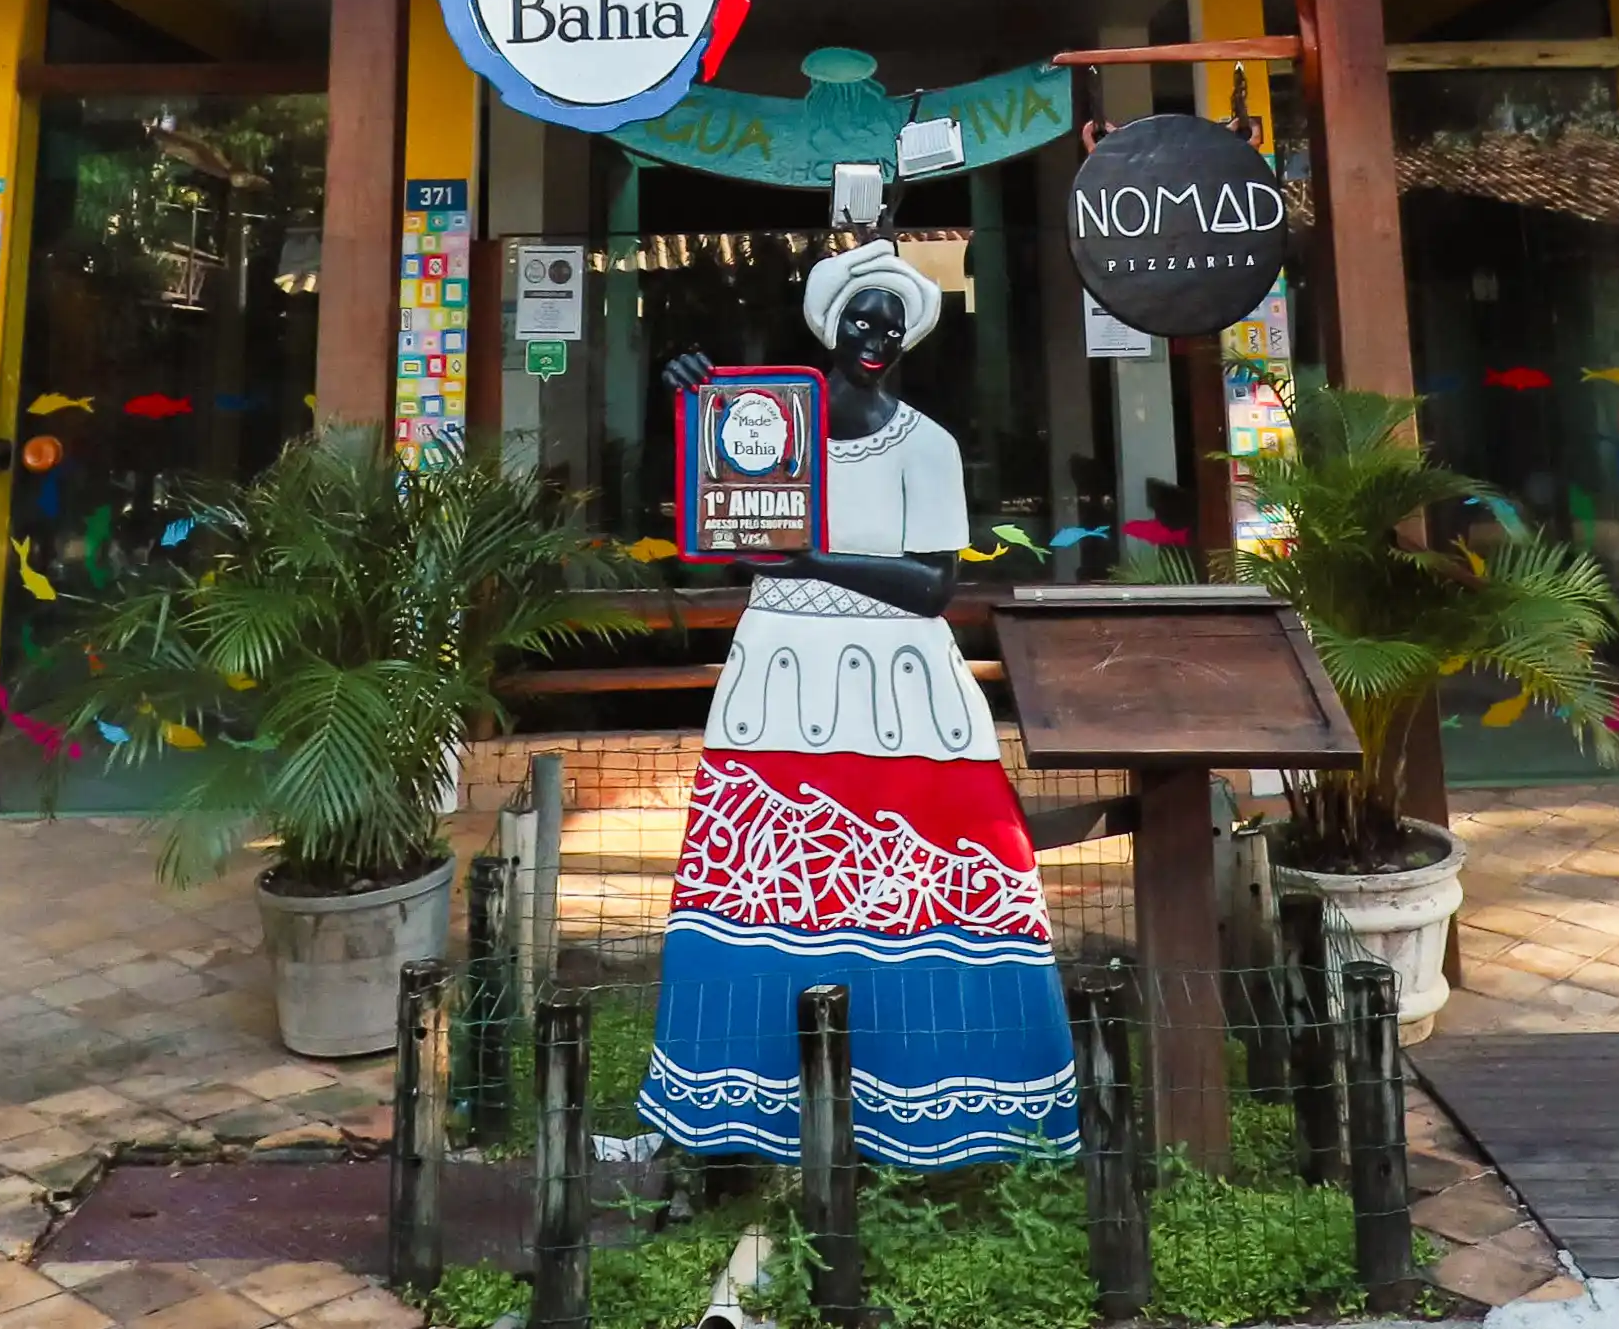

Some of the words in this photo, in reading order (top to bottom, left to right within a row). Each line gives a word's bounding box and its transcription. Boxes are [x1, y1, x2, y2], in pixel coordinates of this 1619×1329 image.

[643, 97, 772, 161] GUA
[419, 186, 453, 206] 371
[1075, 181, 1285, 239] NOMAD
[1107, 254, 1256, 272] PIZZARIA
[738, 413, 772, 427] Made
[733, 441, 777, 456] Bahia
[728, 490, 806, 517] ANDAR
[738, 532, 771, 546] VISA
